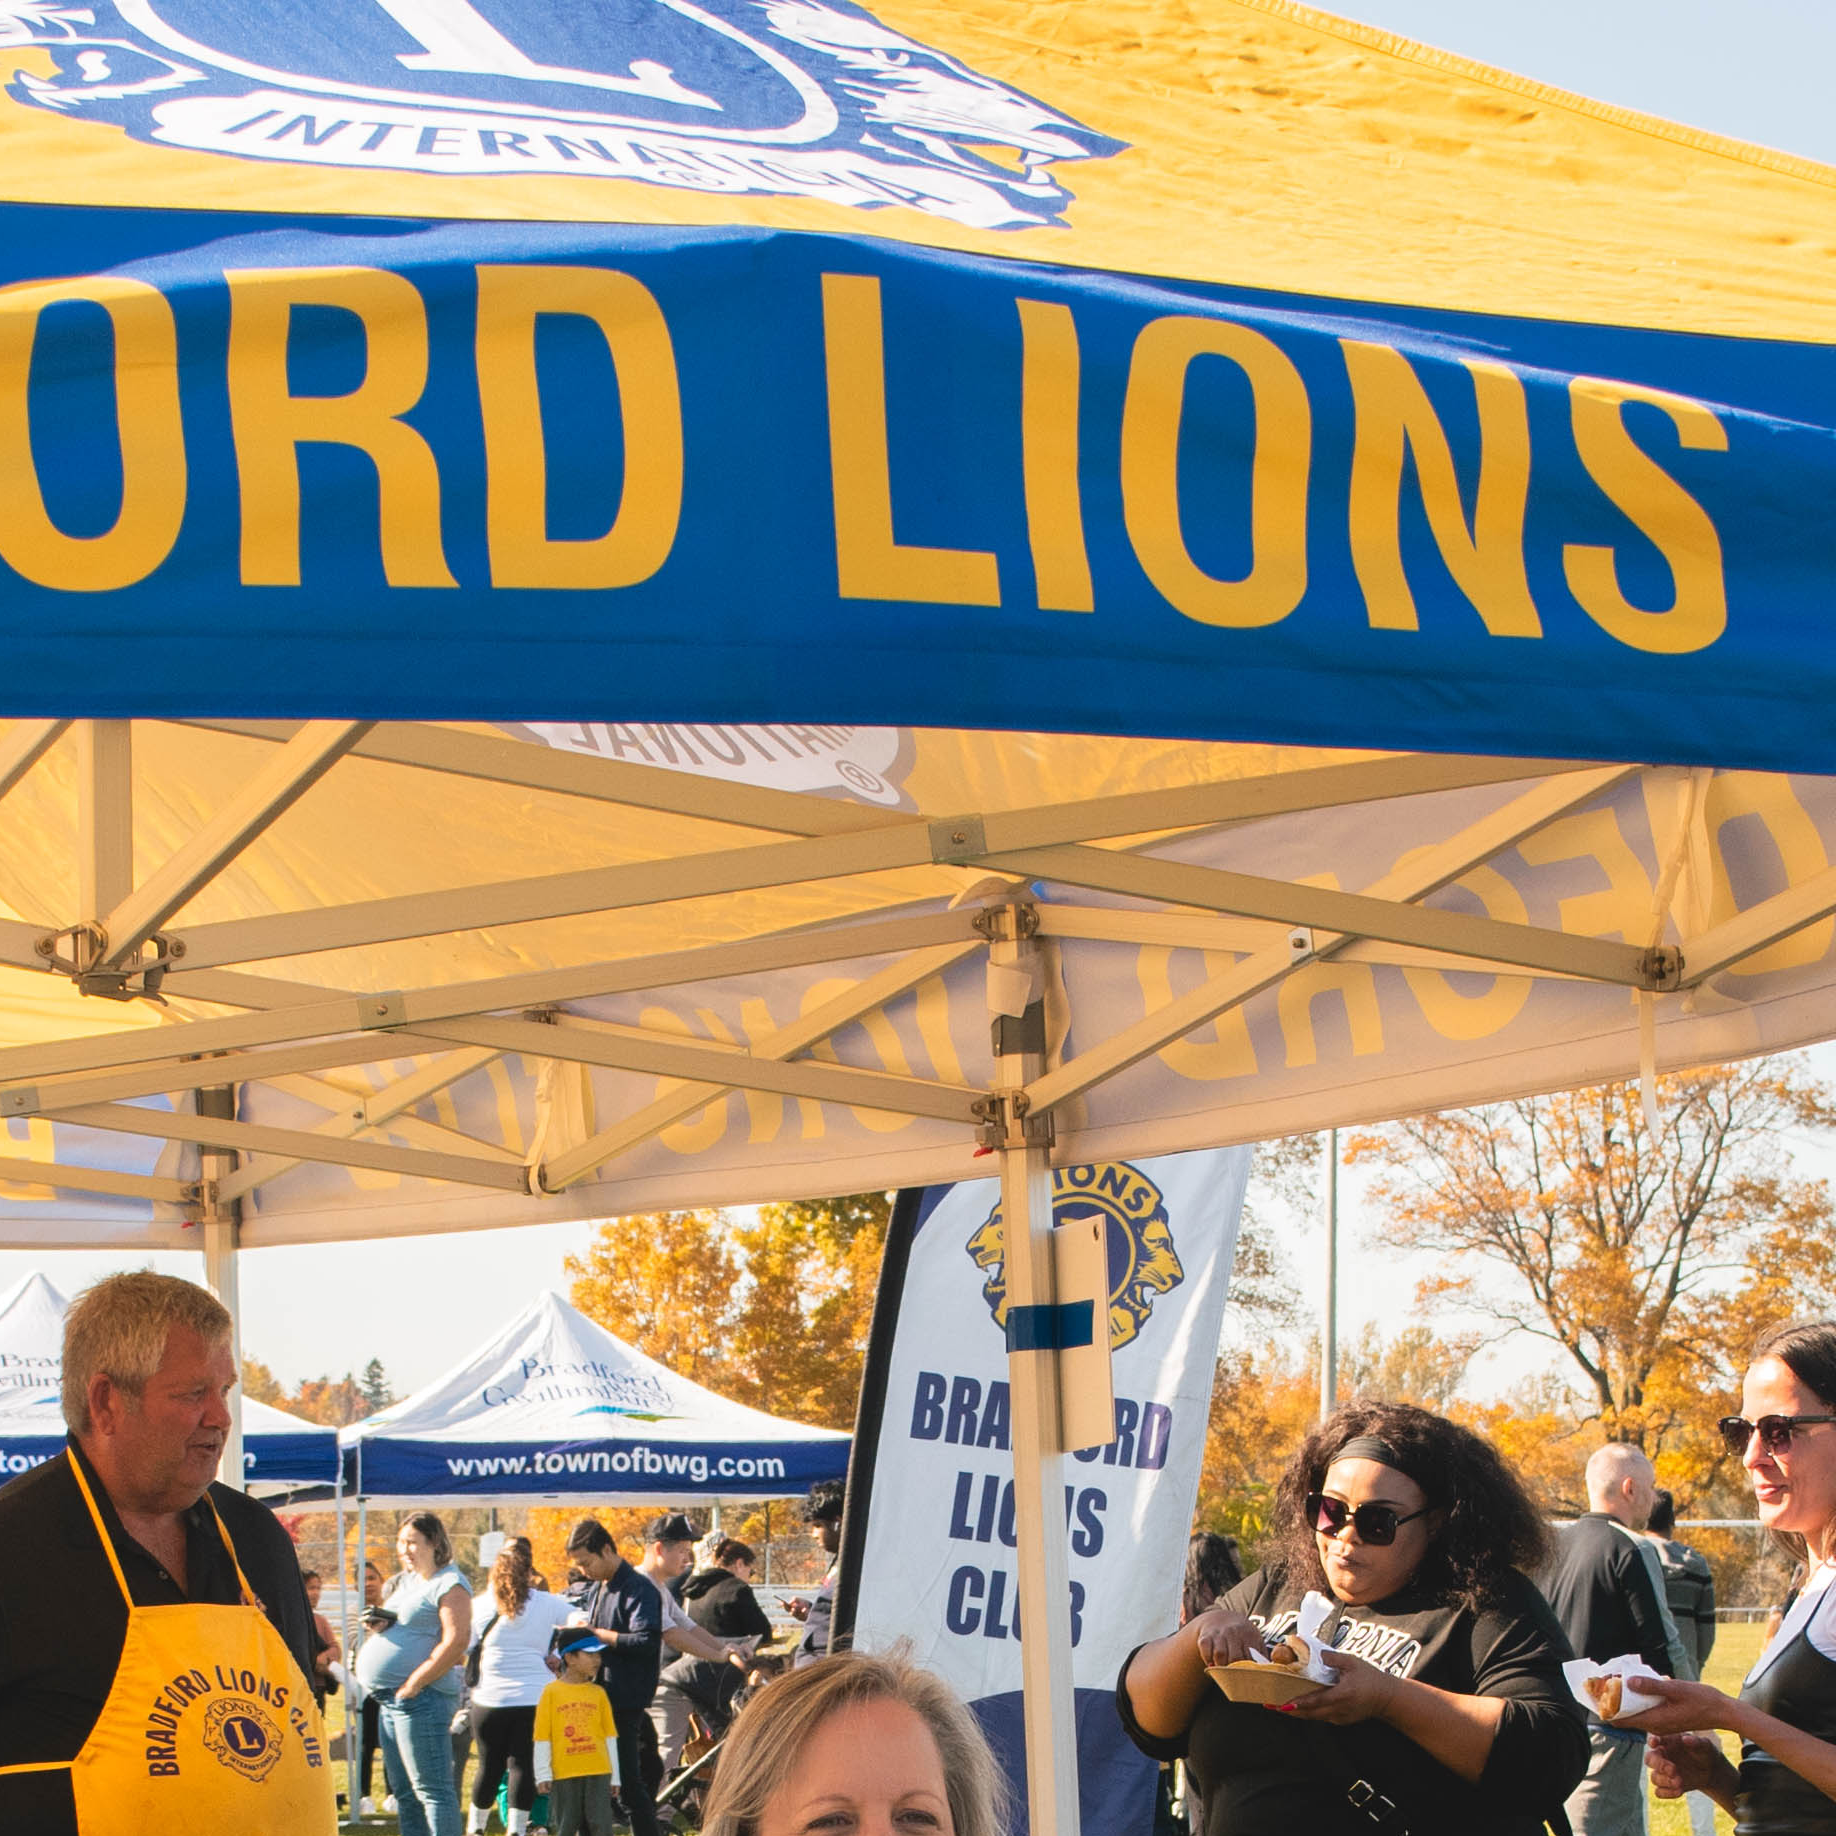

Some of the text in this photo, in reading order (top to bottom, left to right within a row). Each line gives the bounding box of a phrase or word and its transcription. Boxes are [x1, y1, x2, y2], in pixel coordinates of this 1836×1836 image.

[222, 109, 954, 210] INTERNATIOA
[820, 273, 1728, 656] LIONS
[1052, 1165, 1152, 1212] IONS
[910, 1371, 1173, 1470] BRARD
[447, 1447, 785, 1482] www.townofbwg.com
[949, 1471, 1107, 1558] LIS
[946, 1565, 1085, 1648] CLB
[146, 1665, 323, 1776] BRADFORD LIONS CLUB
[214, 1701, 253, 1716] LIONS
[229, 1720, 261, 1750] L
